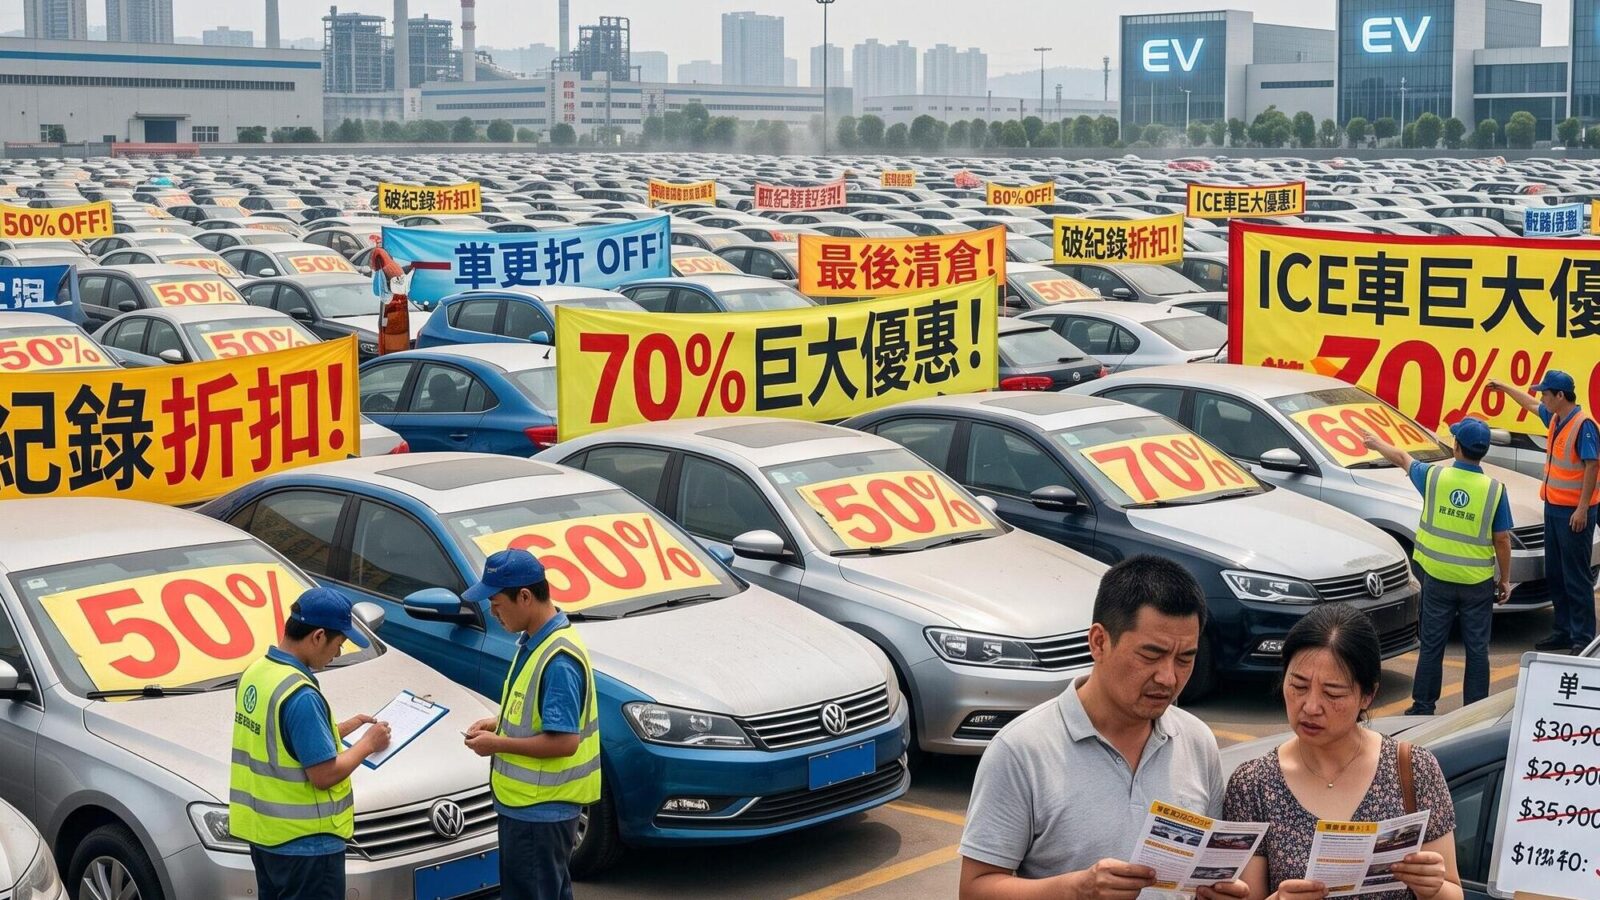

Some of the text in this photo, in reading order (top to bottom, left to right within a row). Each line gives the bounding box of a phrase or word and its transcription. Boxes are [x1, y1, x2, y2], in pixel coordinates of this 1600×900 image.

[1362, 16, 1431, 53] EV
[1143, 38, 1204, 72] EV
[384, 186, 477, 211] 破紀錄折扣!
[1196, 189, 1296, 213] ICE車巨大優惠!
[4, 208, 108, 237] 50% OFF!
[1061, 225, 1177, 260] 破紀錄折扣!
[816, 239, 996, 290] 最後清倉!
[158, 282, 236, 305] 50%
[0, 336, 101, 371] 50%
[579, 298, 982, 423] 70%巨大優惠!
[1307, 405, 1424, 457] 60%
[1089, 437, 1245, 501] 70%
[812, 474, 982, 544] 50%
[507, 517, 701, 602] 60%
[76, 570, 285, 679] 50%
[1526, 757, 1600, 787] $29,90
[433, 801, 464, 837] VW
